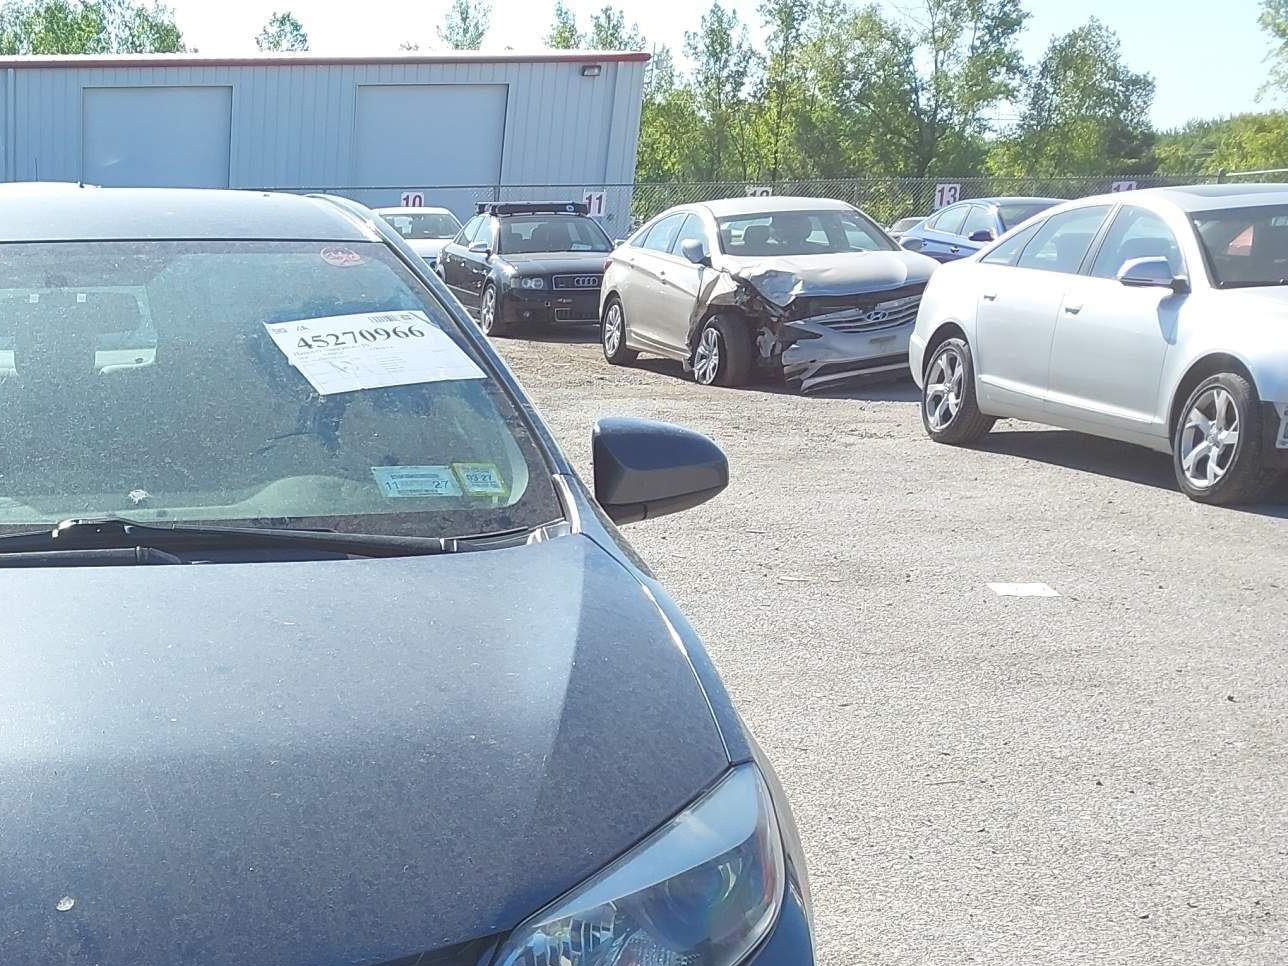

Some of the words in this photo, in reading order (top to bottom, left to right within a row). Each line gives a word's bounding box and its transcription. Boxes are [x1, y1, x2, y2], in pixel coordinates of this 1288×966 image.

[402, 194, 423, 207] 10
[585, 194, 603, 214] 11
[937, 186, 958, 207] 13
[297, 325, 425, 350] 45270966
[432, 480, 449, 489] 27
